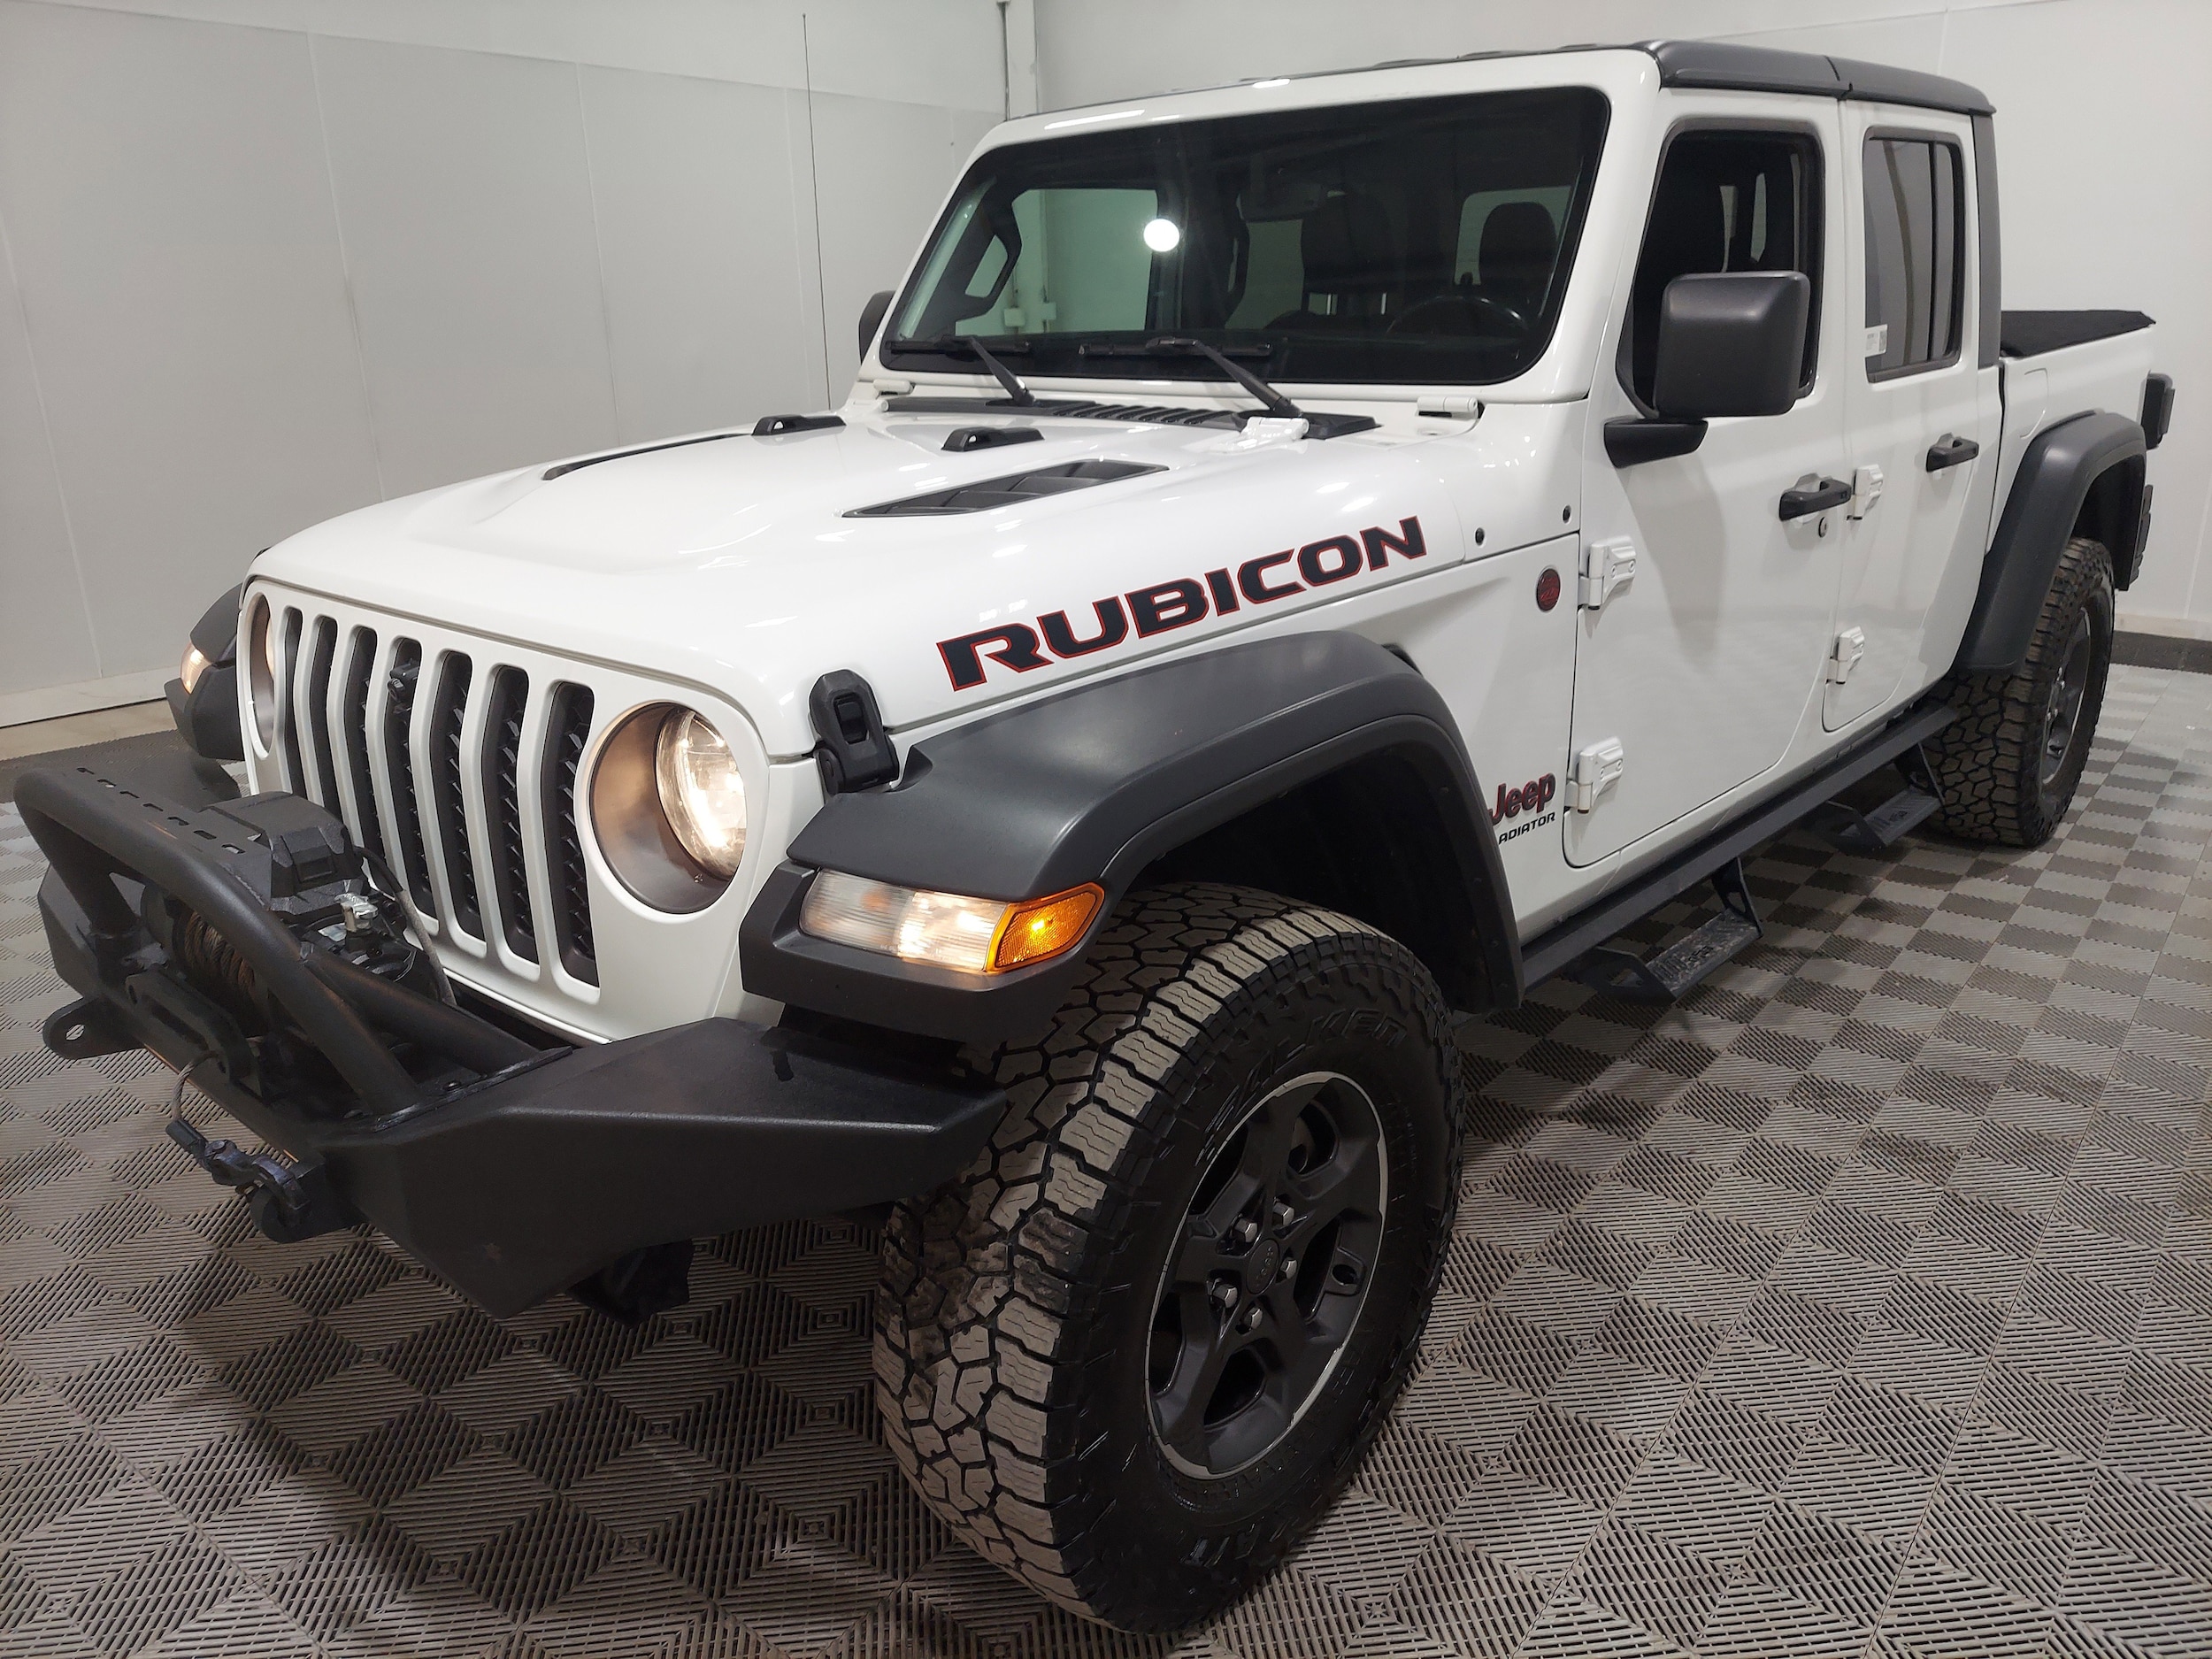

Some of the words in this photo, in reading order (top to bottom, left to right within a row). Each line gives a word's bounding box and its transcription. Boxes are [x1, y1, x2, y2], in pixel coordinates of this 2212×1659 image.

[936, 516, 1426, 692] RUBICON
[1487, 772, 1556, 826] Jeep
[1498, 811, 1555, 845] ADIATOR
